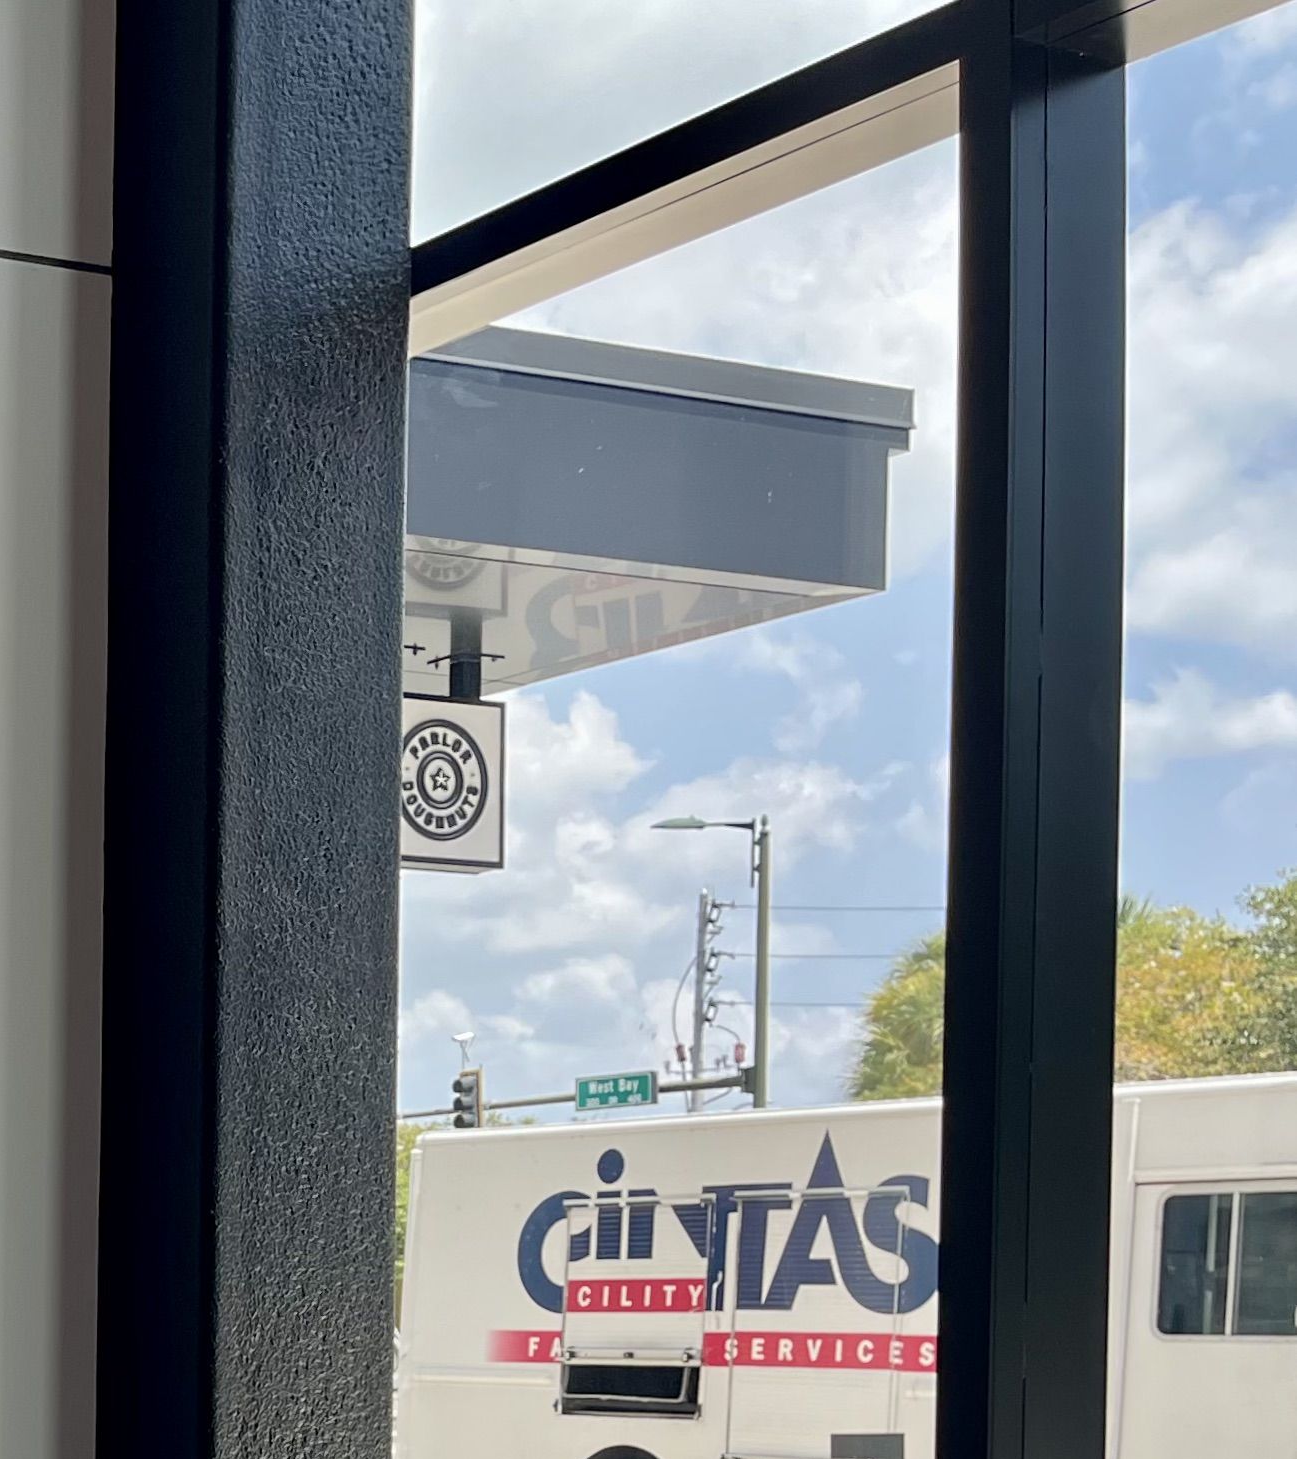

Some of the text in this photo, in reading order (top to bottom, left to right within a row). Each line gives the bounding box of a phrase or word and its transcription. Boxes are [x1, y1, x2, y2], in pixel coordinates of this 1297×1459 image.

[409, 732, 473, 765] PARLOR
[402, 781, 479, 829] DOUGHNUTS
[588, 1078, 640, 1095] West Bay
[724, 1338, 936, 1367] SERVICES
